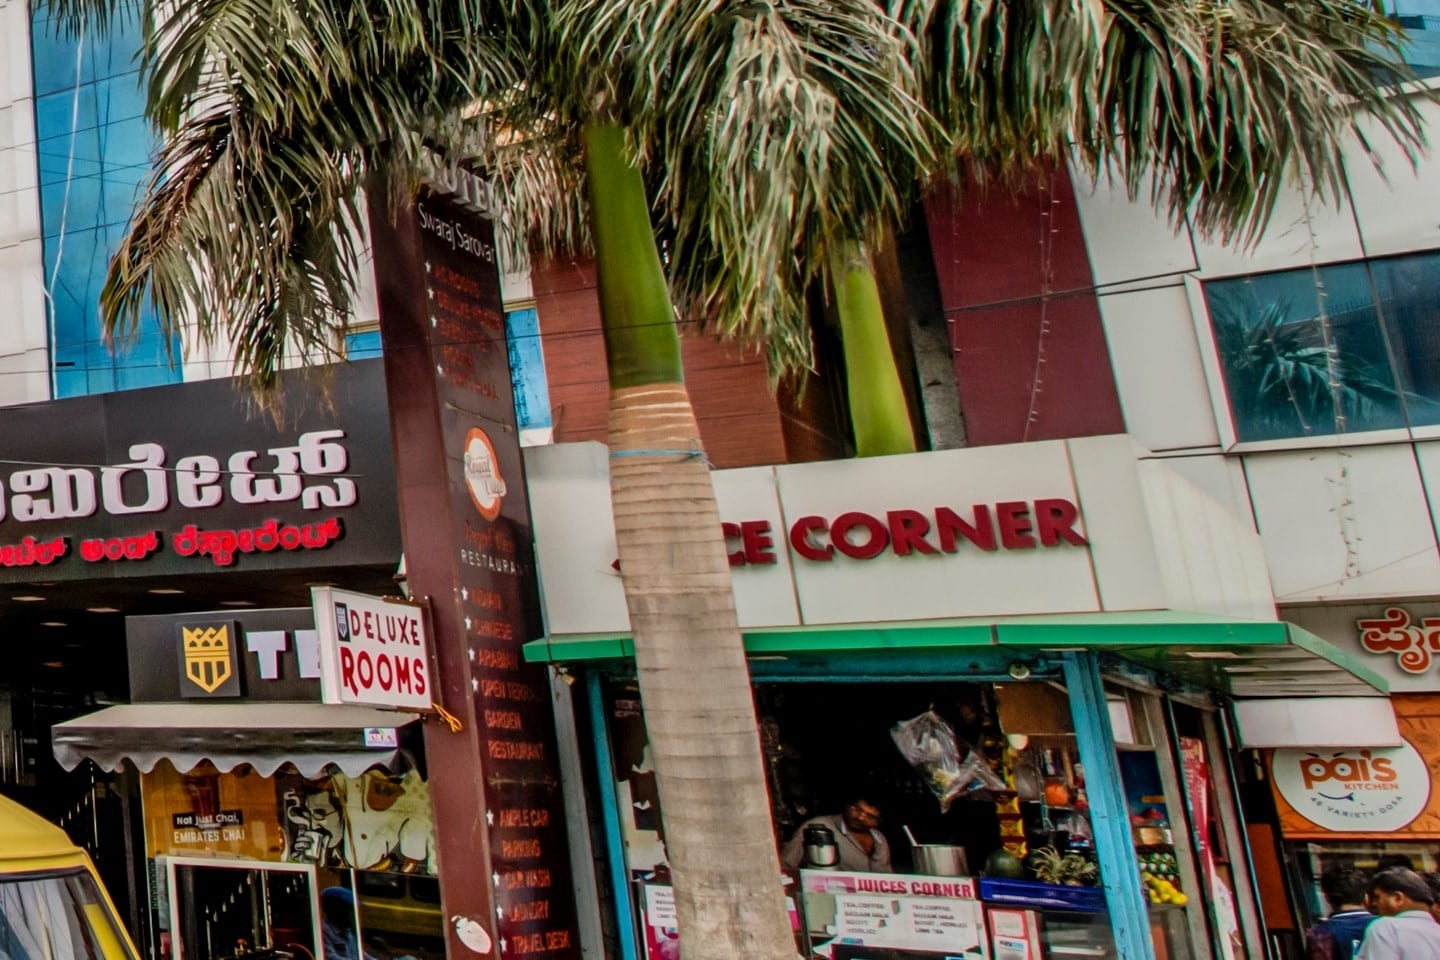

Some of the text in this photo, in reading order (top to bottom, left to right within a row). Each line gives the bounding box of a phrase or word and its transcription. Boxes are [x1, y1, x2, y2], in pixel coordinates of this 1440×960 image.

[418, 202, 495, 264] Swaraj Sarovar
[790, 498, 1090, 561] CORNER
[350, 608, 420, 646] DELUXE
[340, 646, 426, 697] ROOMS
[485, 710, 522, 730] GARDEN
[487, 740, 544, 761] RESTAURANT
[1343, 783, 1399, 791] KITCHEN
[1327, 805, 1375, 819] VARIETY
[1379, 795, 1403, 815] DOSA
[530, 808, 549, 827] CAR
[174, 828, 246, 844] EMIRATES CHAI
[502, 840, 541, 858] PARKING
[857, 879, 971, 898] JUICES CORNER
